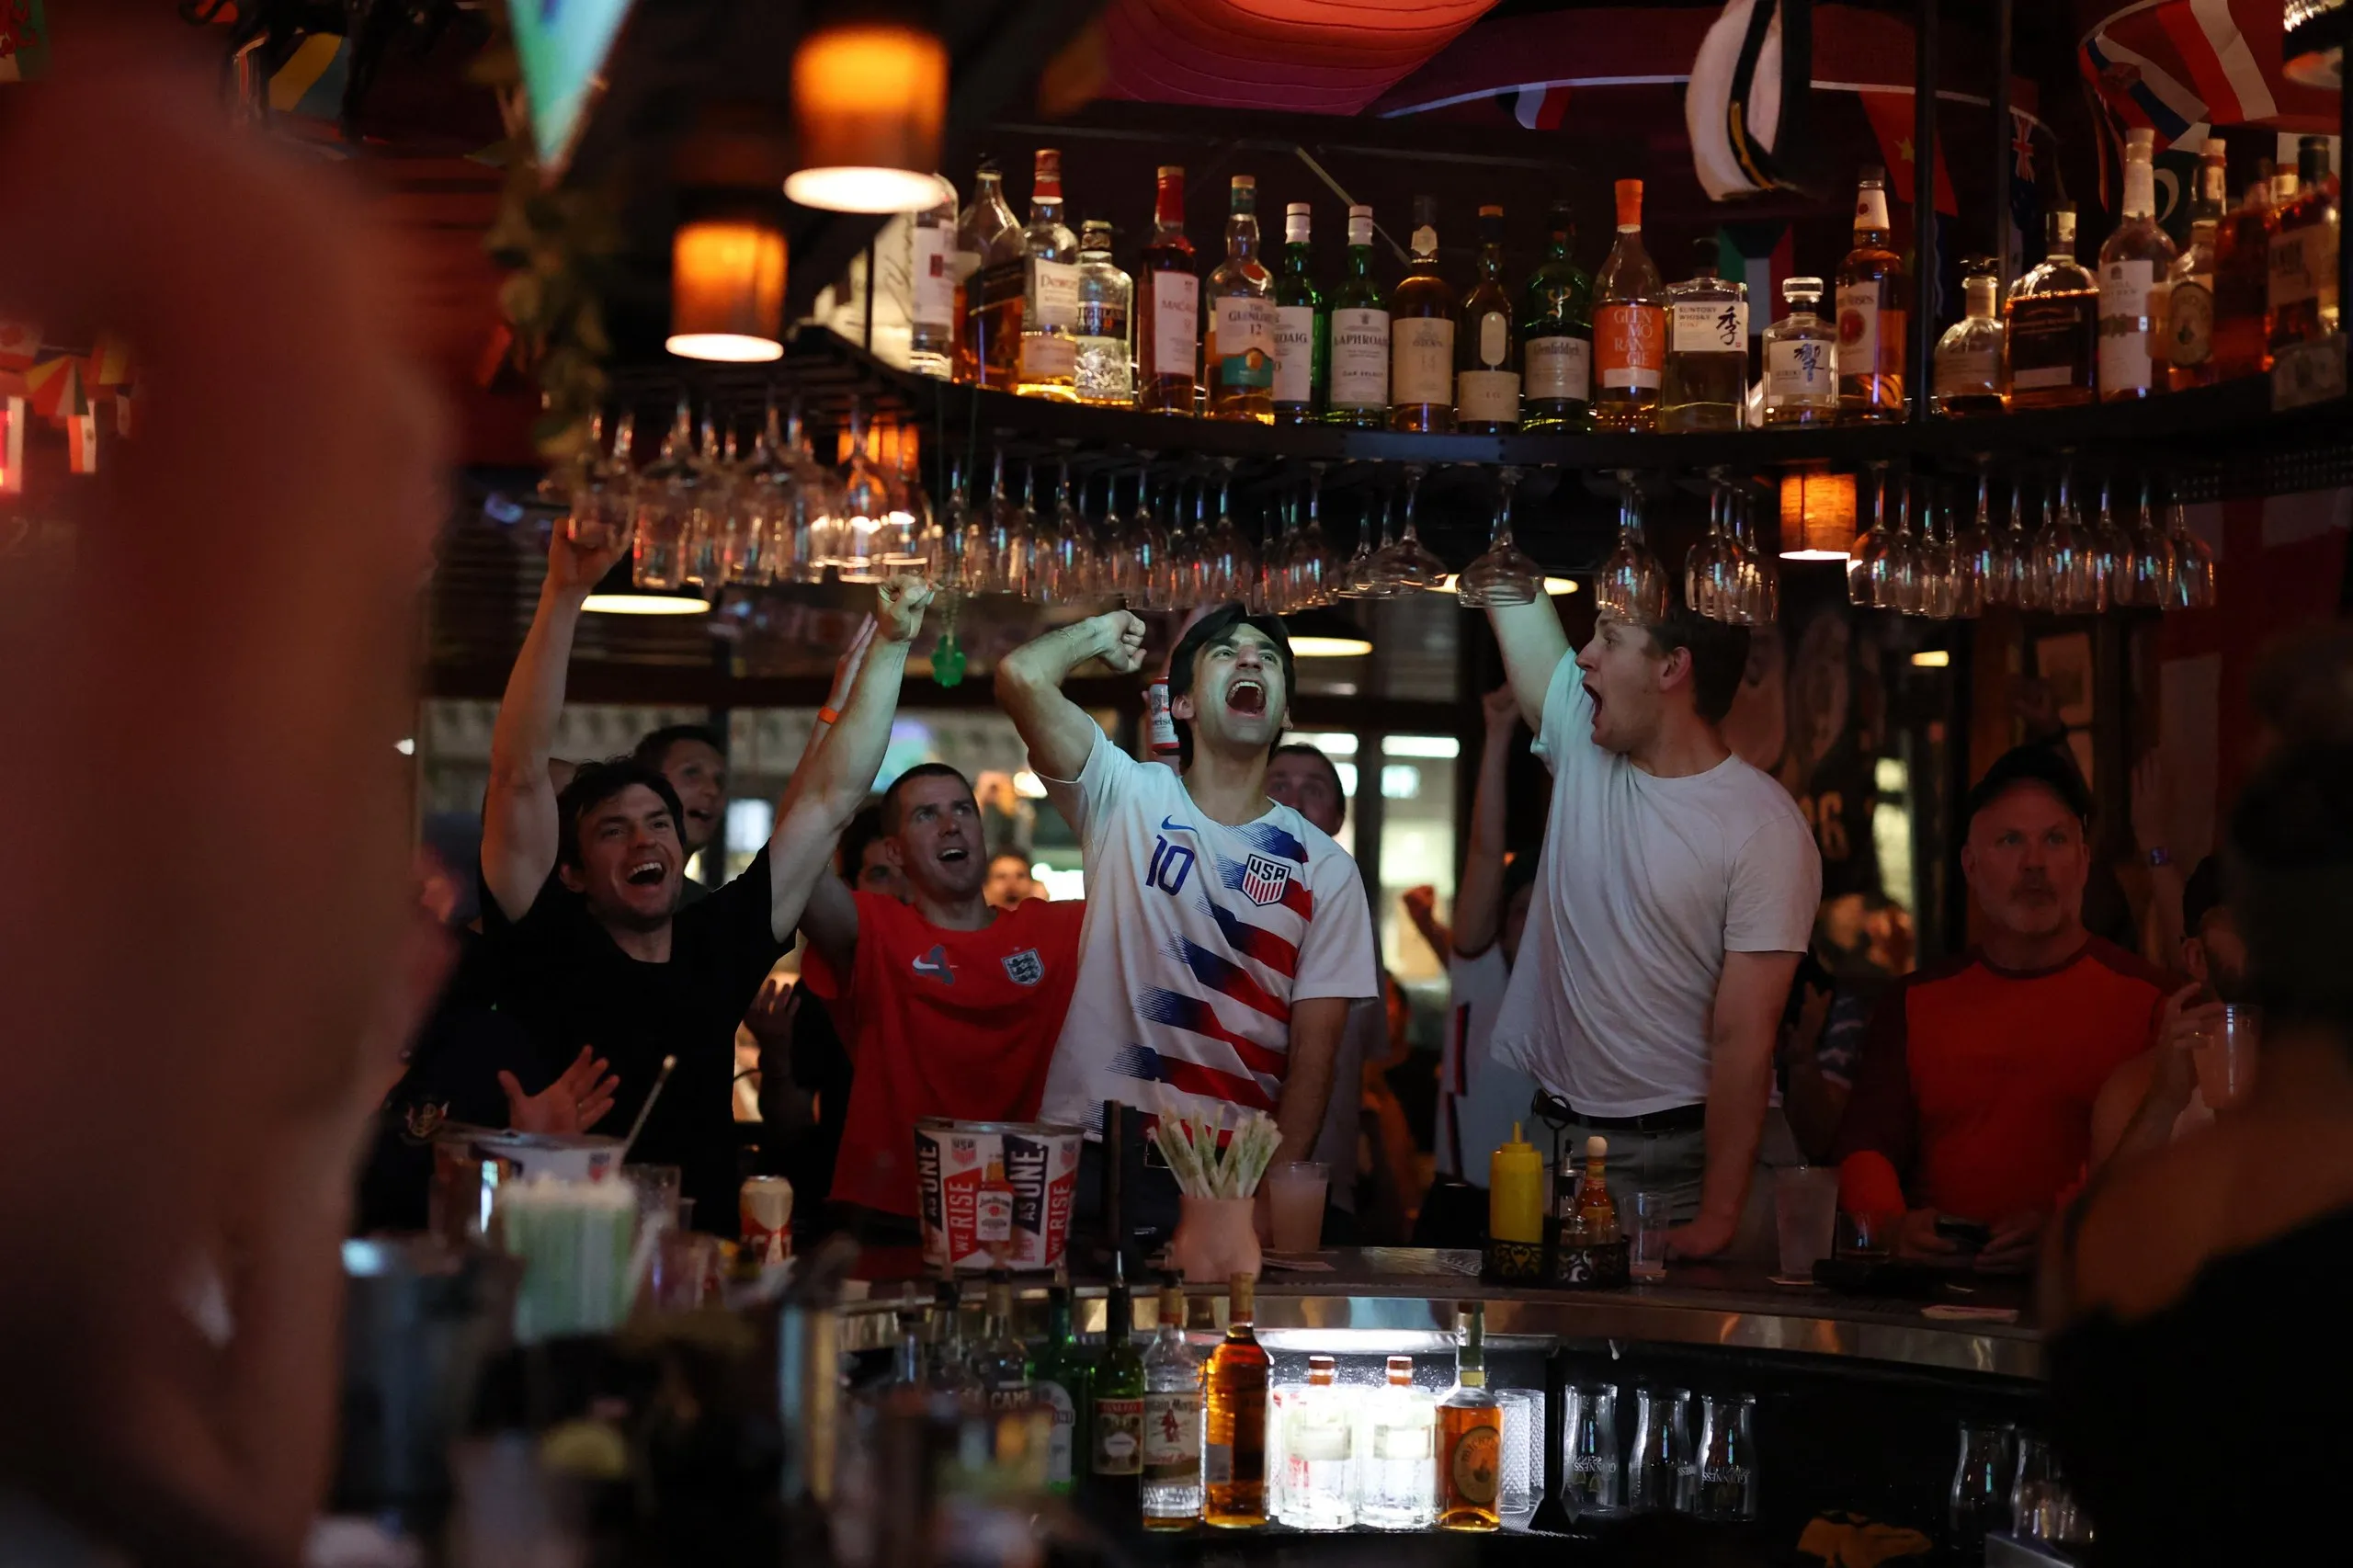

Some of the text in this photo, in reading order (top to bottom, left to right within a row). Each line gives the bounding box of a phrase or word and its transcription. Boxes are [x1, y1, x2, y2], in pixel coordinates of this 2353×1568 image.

[1613, 309, 1654, 324] GLEN
[1716, 305, 1741, 346] 季
[1250, 324, 1263, 336] 12
[1628, 323, 1654, 338] MO
[1626, 350, 1650, 366] GIE
[1145, 834, 1195, 896] 10
[1248, 857, 1288, 881] USA
[952, 1138, 976, 1151] USA
[949, 1181, 974, 1253] WE RISE
[1018, 1200, 1037, 1222] AS
[1049, 1184, 1071, 1231] RISE
[990, 1391, 1032, 1411] CAMP
